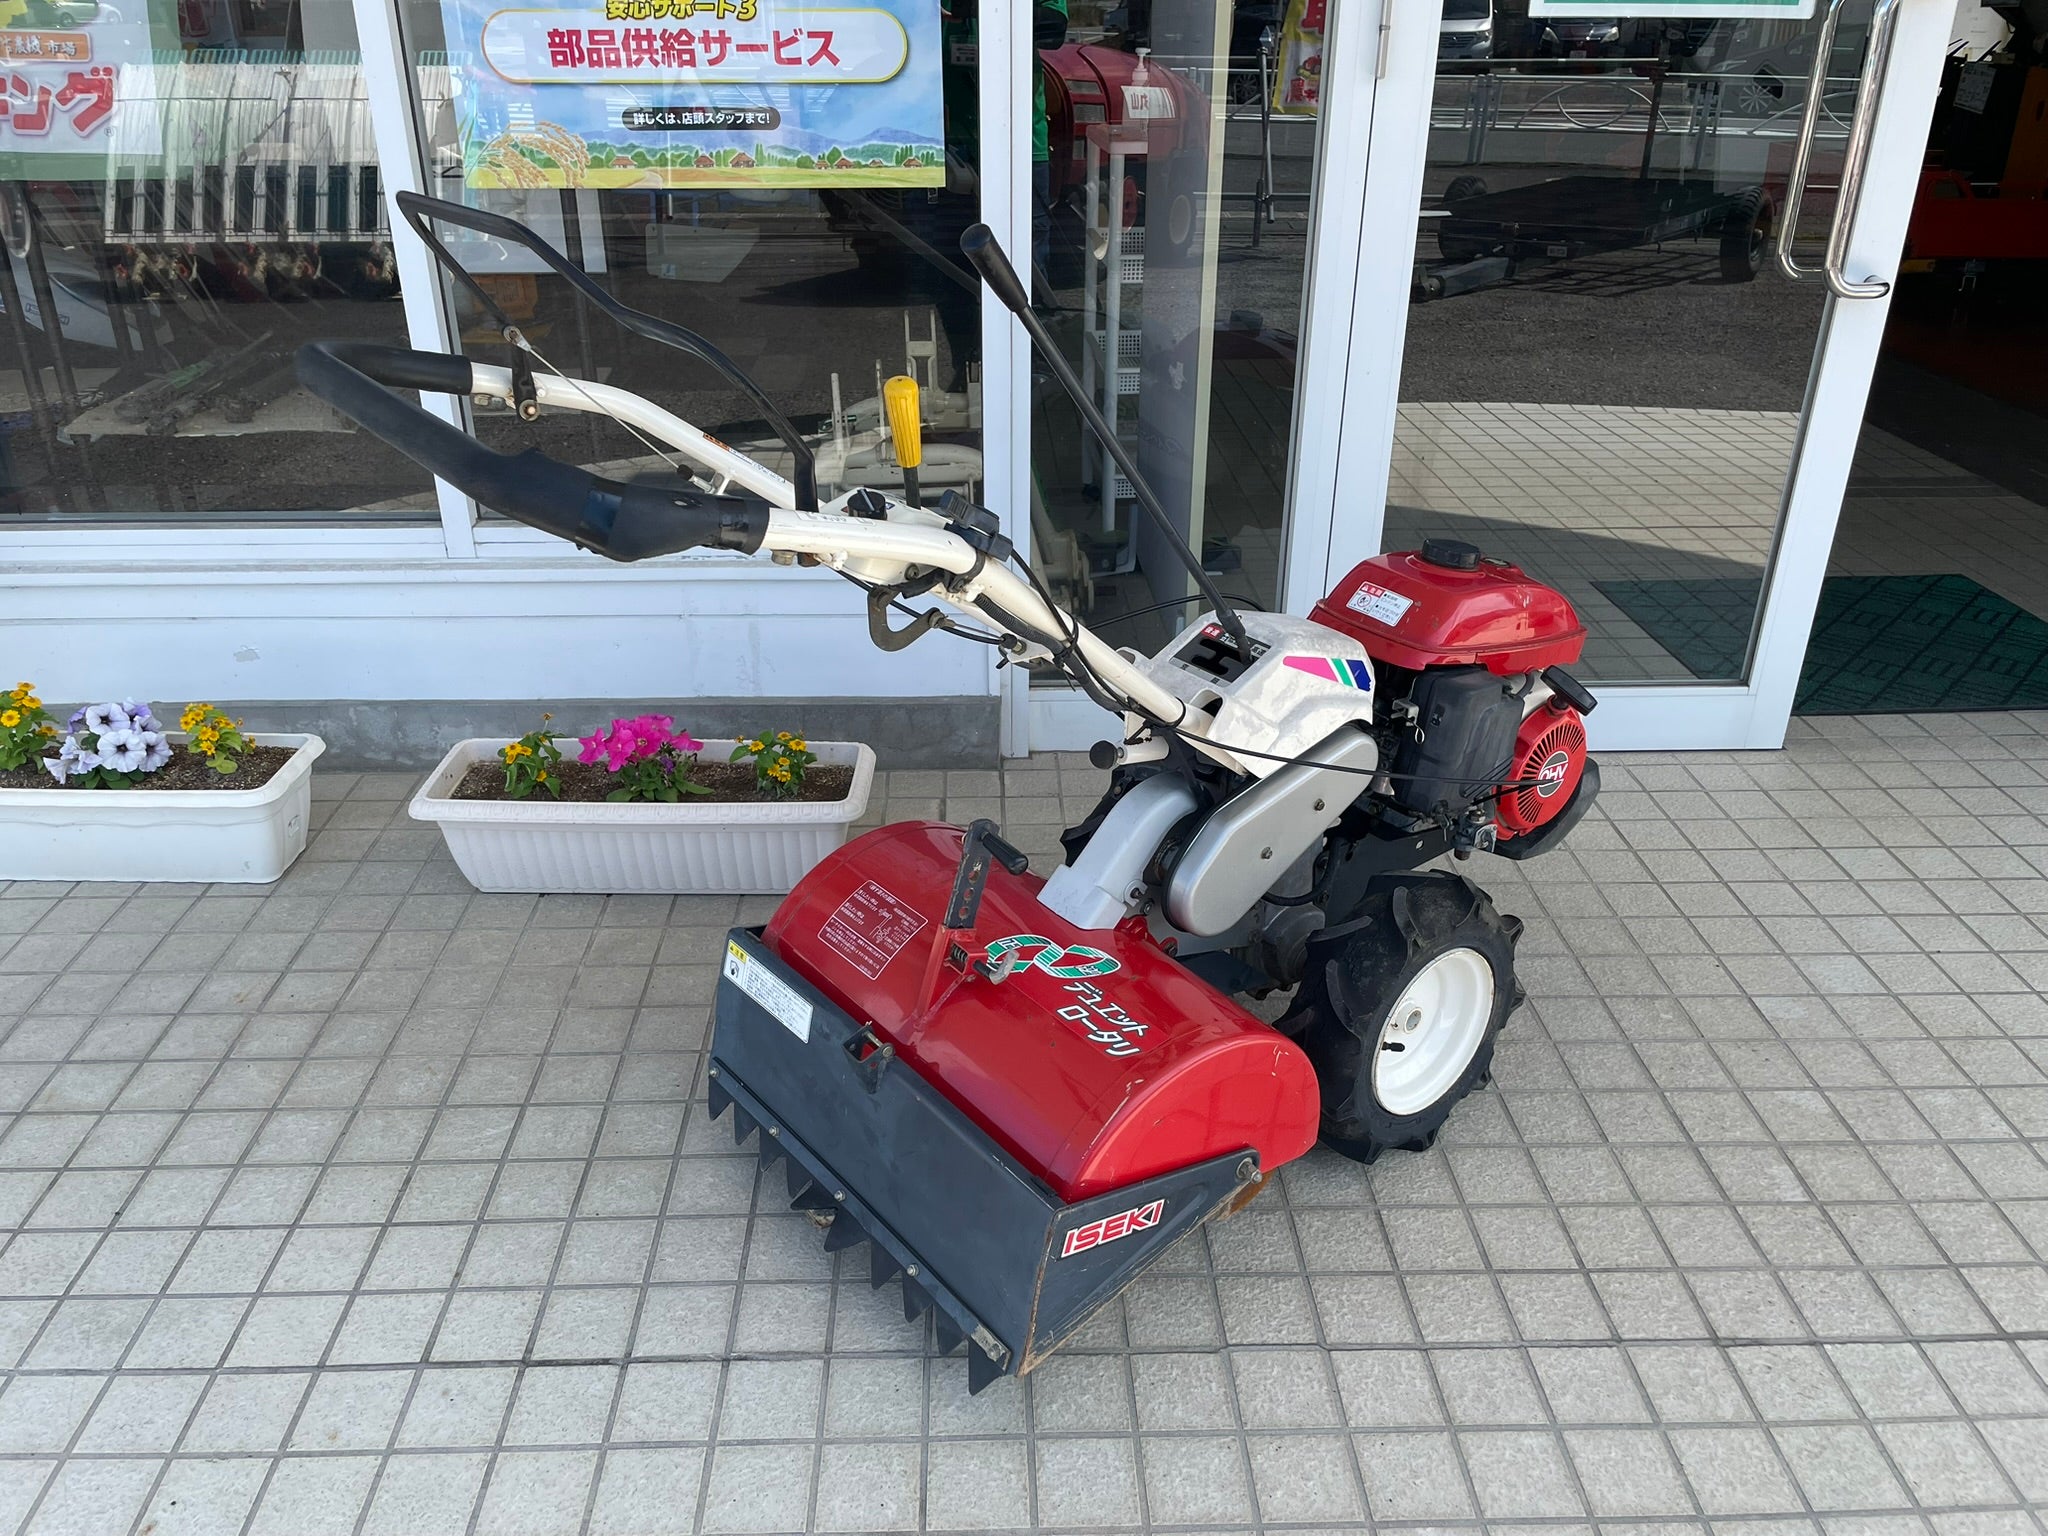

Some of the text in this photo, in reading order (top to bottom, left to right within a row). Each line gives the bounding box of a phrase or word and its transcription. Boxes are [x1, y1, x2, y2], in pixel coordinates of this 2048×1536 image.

[547, 28, 841, 68] 部品供給サービス
[1056, 1004, 1141, 1057] ロータリ
[1062, 981, 1149, 1037] デュエット
[1062, 1200, 1164, 1256] ISEKI
